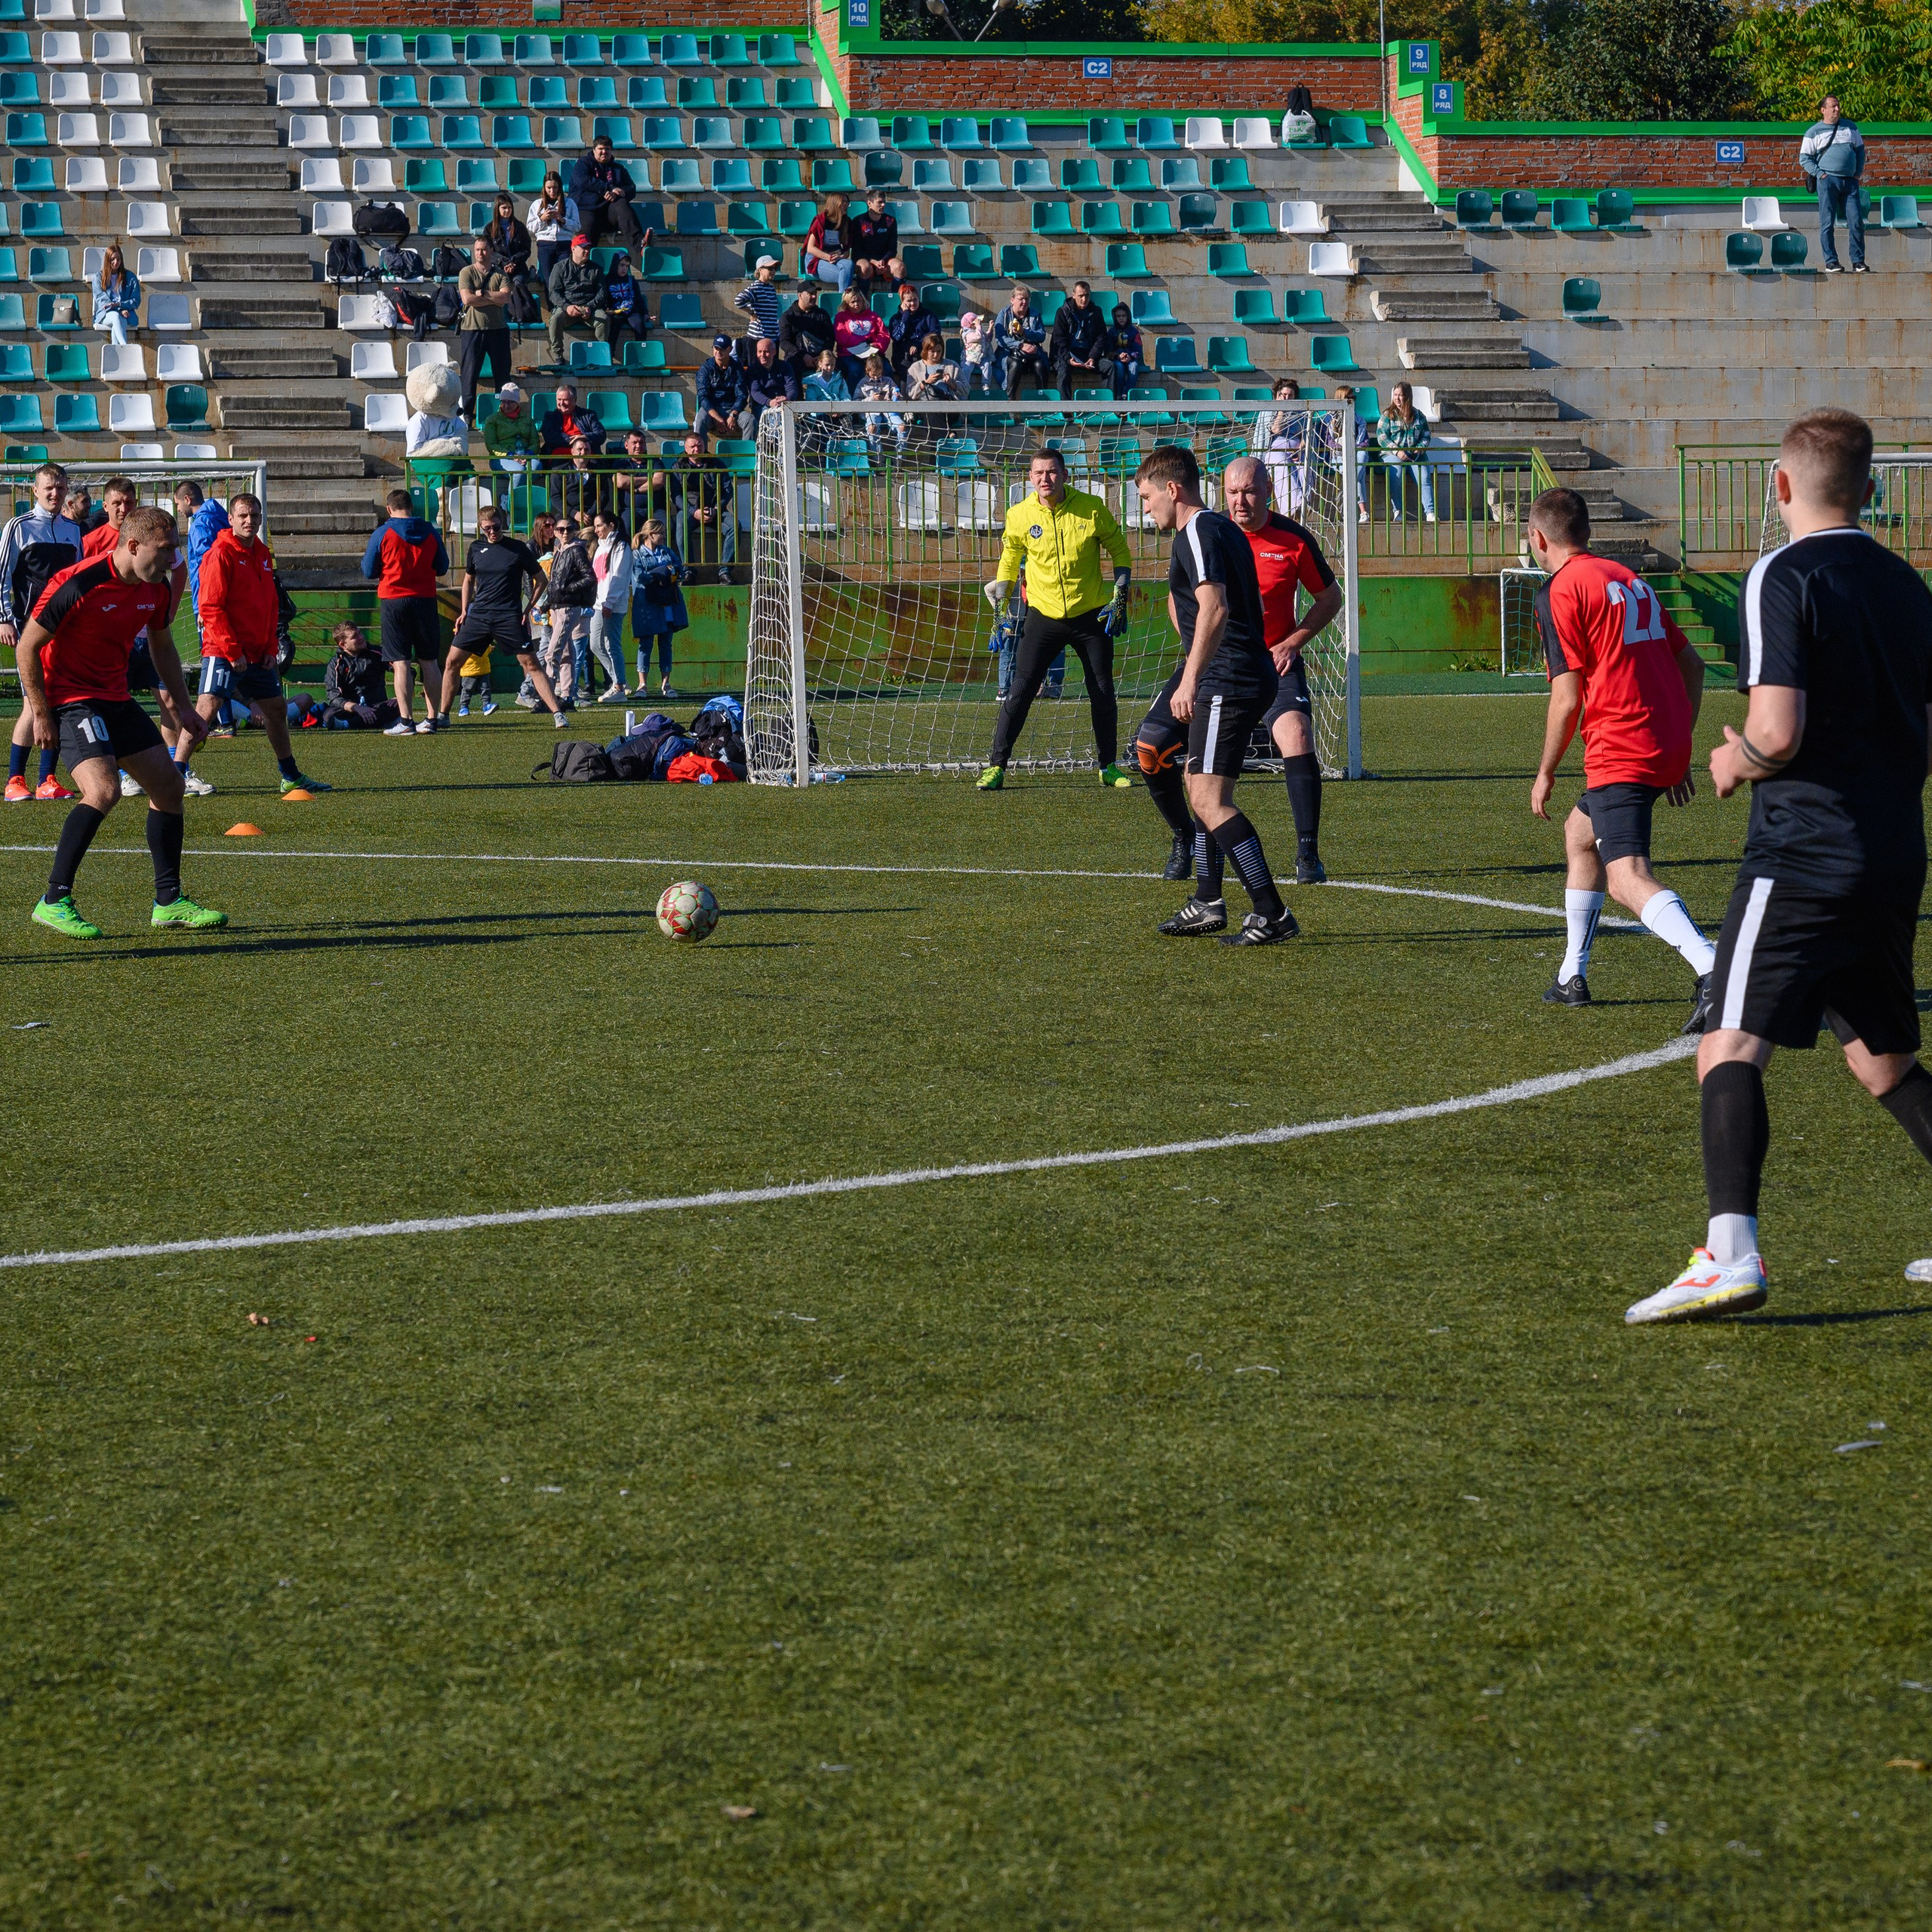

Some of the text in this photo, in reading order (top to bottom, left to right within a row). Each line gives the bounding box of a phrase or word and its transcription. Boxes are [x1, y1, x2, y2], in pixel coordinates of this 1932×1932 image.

[851, 2, 866, 13] 10
[1415, 49, 1423, 59] 9
[1439, 89, 1447, 100] 8
[1607, 578, 1666, 645] 22
[216, 668, 230, 689] 11
[77, 715, 109, 743] 10
